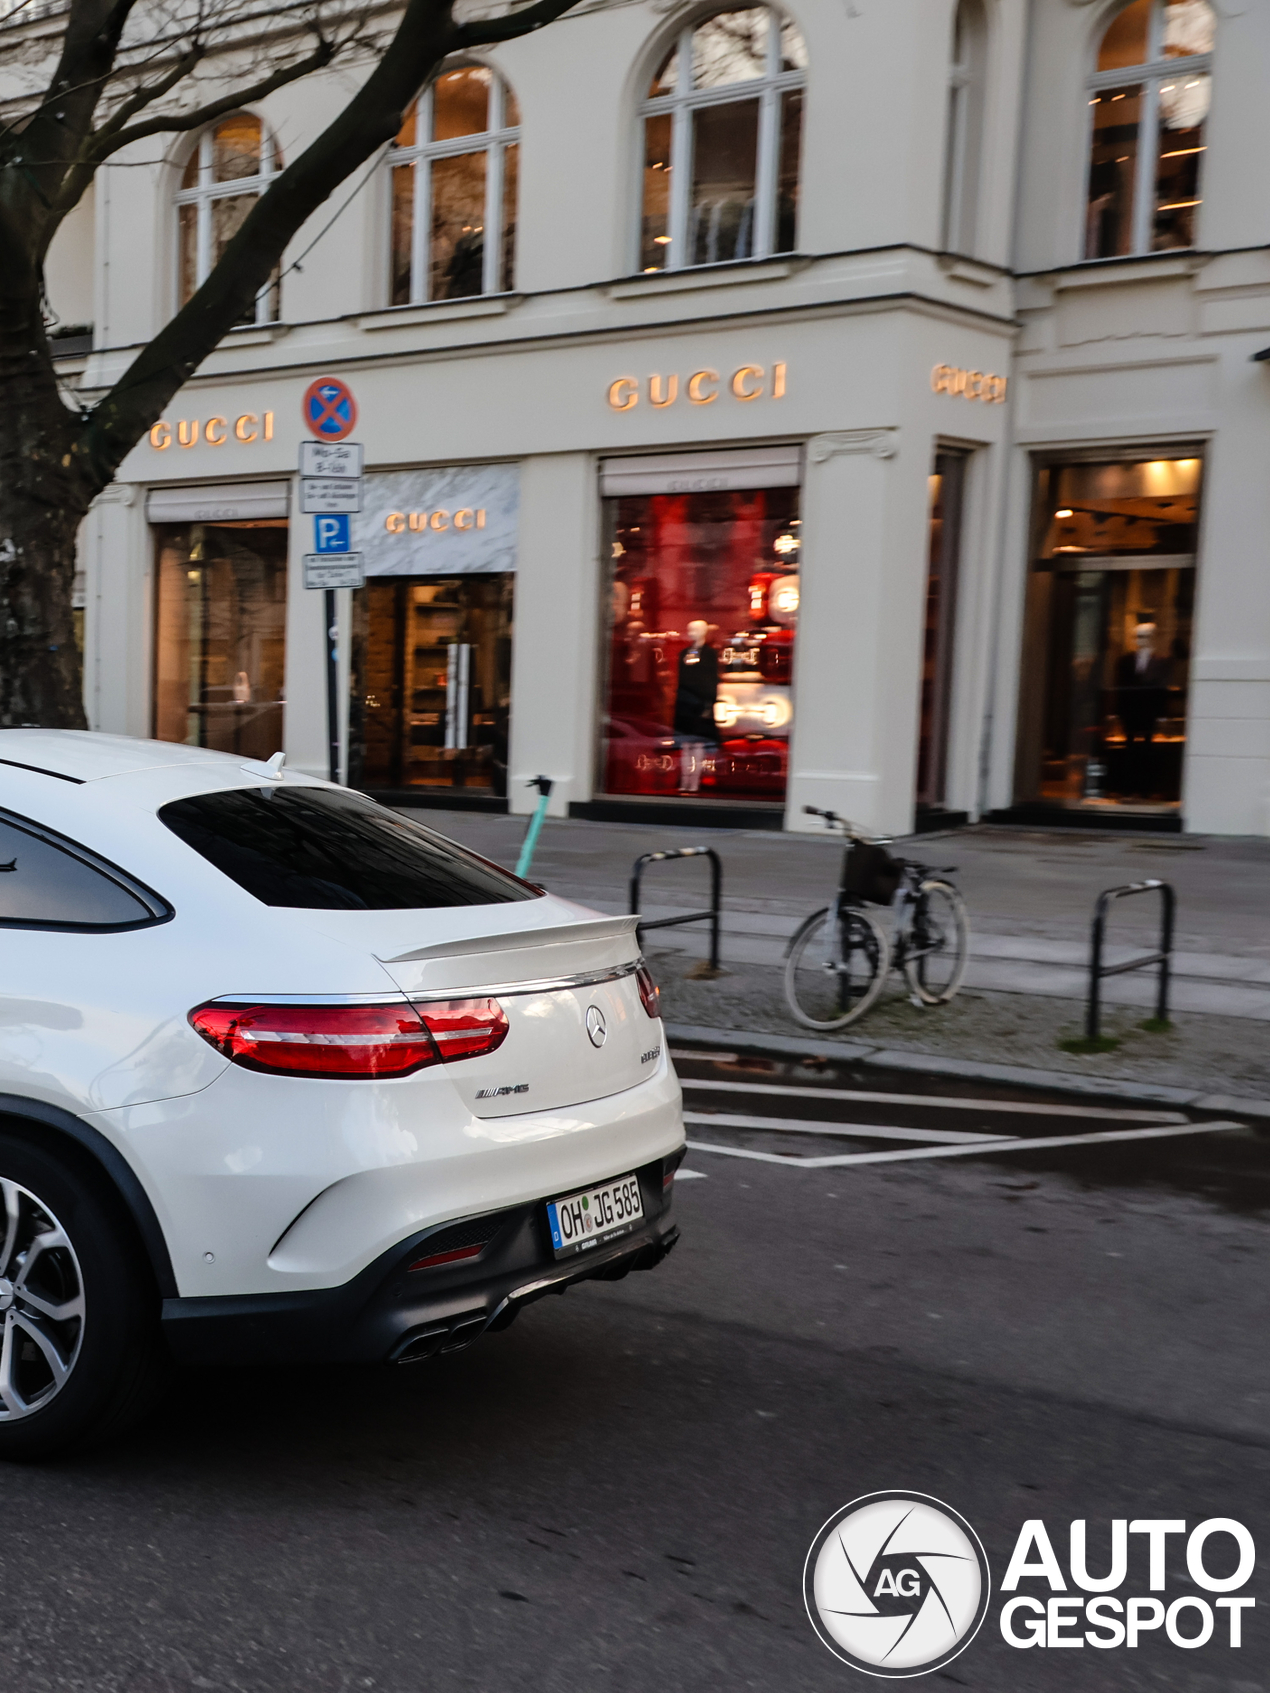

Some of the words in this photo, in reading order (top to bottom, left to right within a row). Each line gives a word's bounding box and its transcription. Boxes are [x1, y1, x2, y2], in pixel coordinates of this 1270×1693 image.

[609, 361, 787, 412] GUCCI
[930, 363, 1007, 404] GUCCI
[150, 409, 274, 451] GUCCI
[318, 518, 340, 548] P
[385, 508, 486, 534] GUCCI
[560, 1201, 585, 1239] OH
[594, 1191, 615, 1228] JG
[613, 1181, 640, 1219] 585
